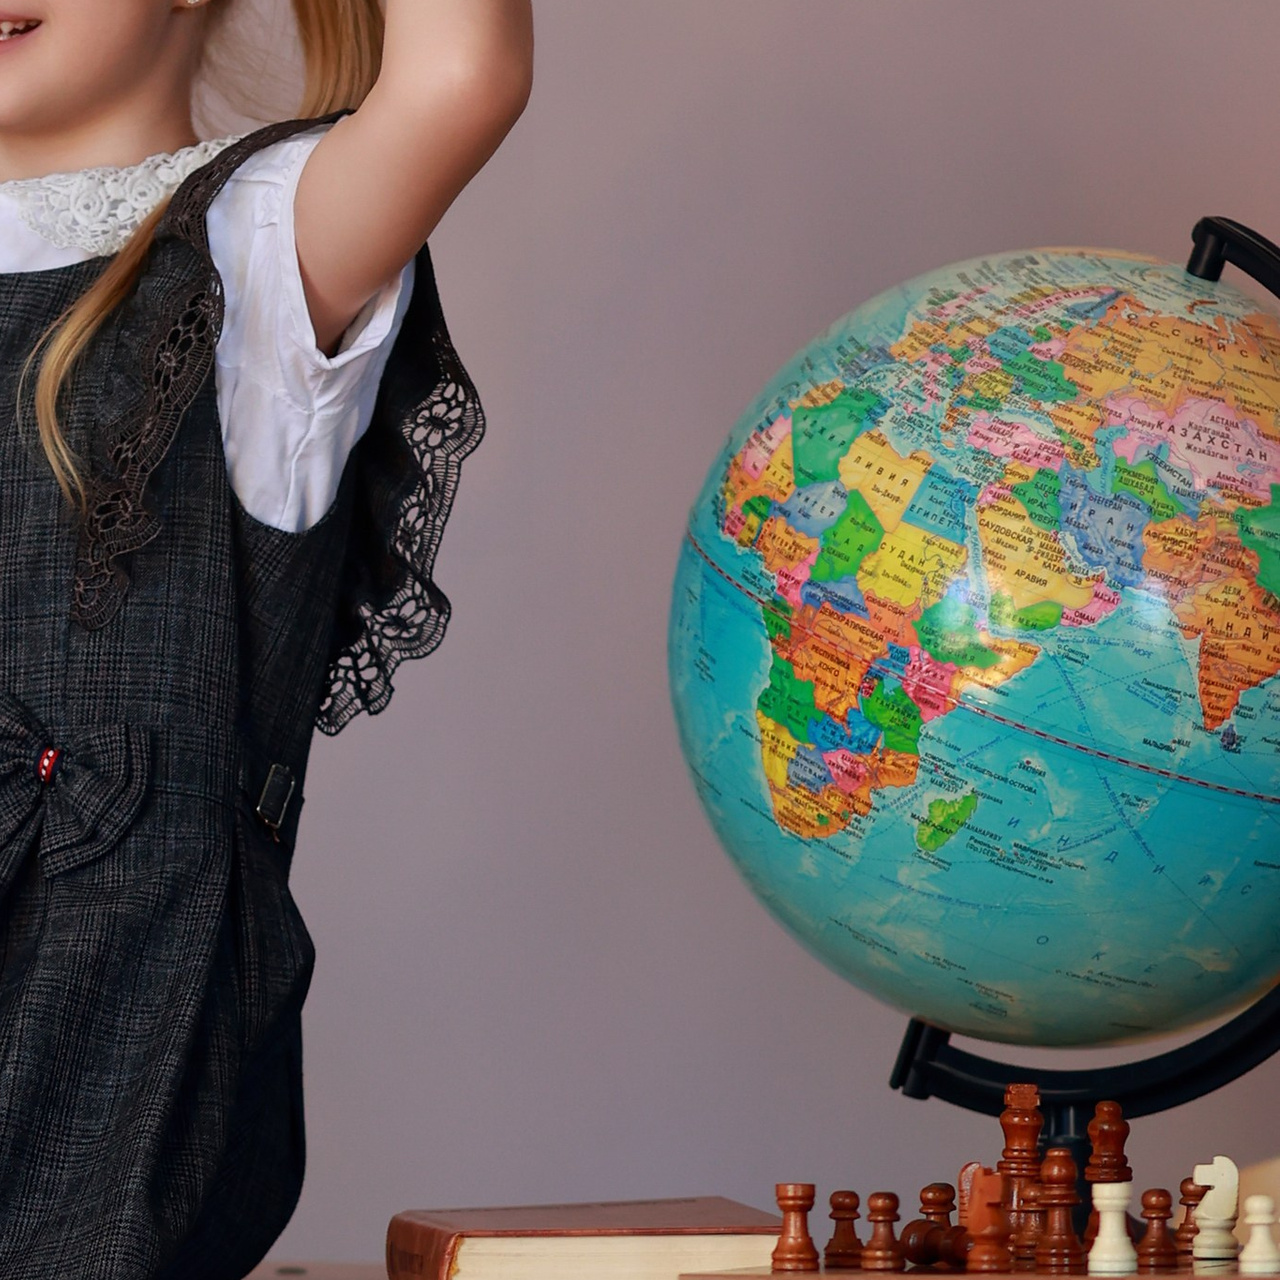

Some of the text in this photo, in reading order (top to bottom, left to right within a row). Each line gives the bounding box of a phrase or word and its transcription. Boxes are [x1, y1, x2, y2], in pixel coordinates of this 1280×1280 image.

[1156, 421, 1267, 461] КАЗАХСТАН
[854, 455, 909, 487] ЛИВИЯ
[1005, 469, 1029, 482] СИРИЯ
[1144, 450, 1192, 488] УЗБЕКИСТАН
[1028, 497, 1047, 509] ИРАК
[909, 505, 953, 527] ЕГИПЕТ
[1028, 512, 1058, 526] КУВЕЙТ
[978, 518, 1033, 545] САУДОВСКАЯ
[880, 542, 925, 567] СУДАН
[1014, 569, 1048, 587] АРАВИЯ
[1147, 570, 1188, 588] ПАКИСТАН
[1221, 585, 1241, 596] ДЕЛИ
[819, 605, 884, 643] ДЕМОКРАТИЧЕСКАЯ
[1073, 610, 1095, 623] ОМАН
[811, 643, 850, 670] РЕСПУБЛИКА
[818, 662, 839, 677] КОНГО
[1008, 779, 1037, 795] ОСТРОВА
